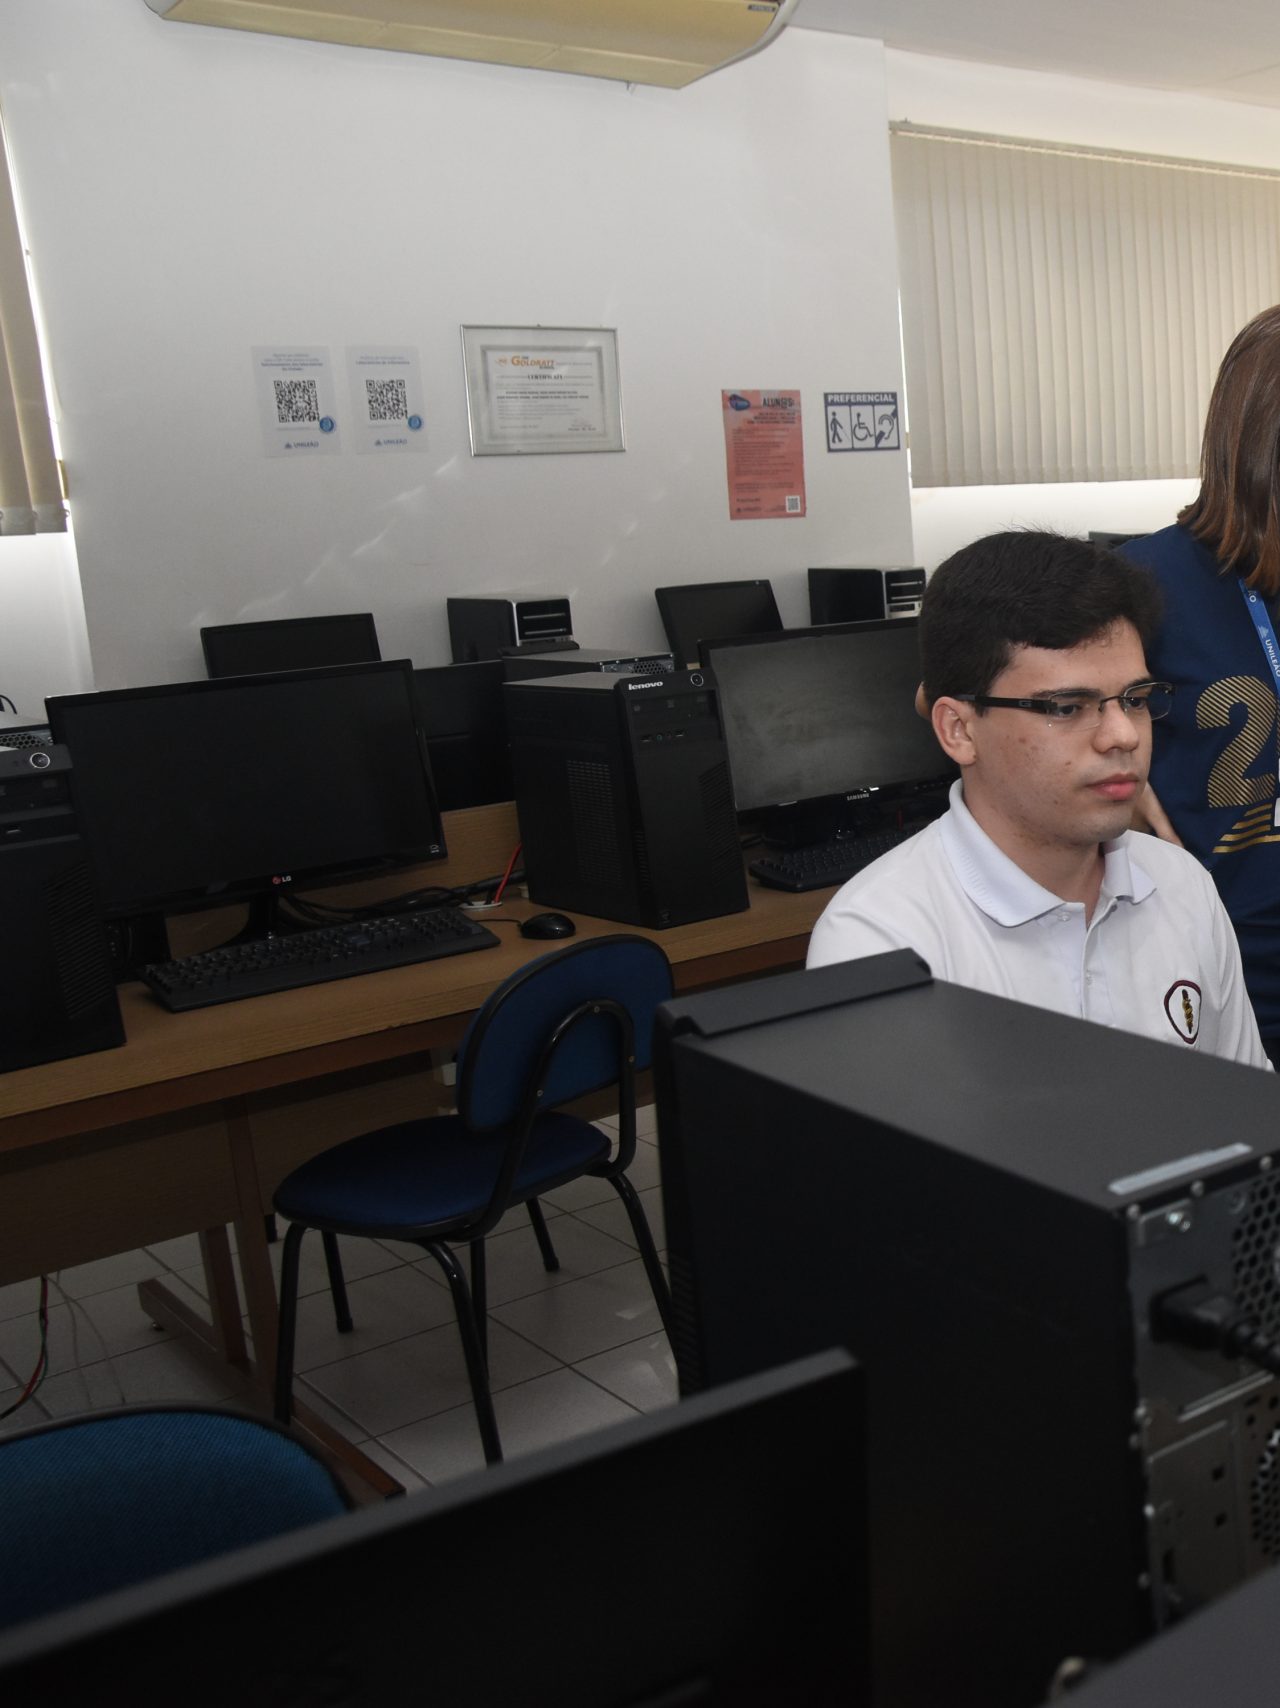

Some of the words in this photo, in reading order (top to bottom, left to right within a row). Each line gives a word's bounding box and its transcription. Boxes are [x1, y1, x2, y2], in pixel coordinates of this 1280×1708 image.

[827, 393, 894, 403] PREFERENCIAL
[628, 681, 663, 690] lenovo
[846, 792, 870, 801] SAMSUNG
[282, 875, 292, 883] LG
